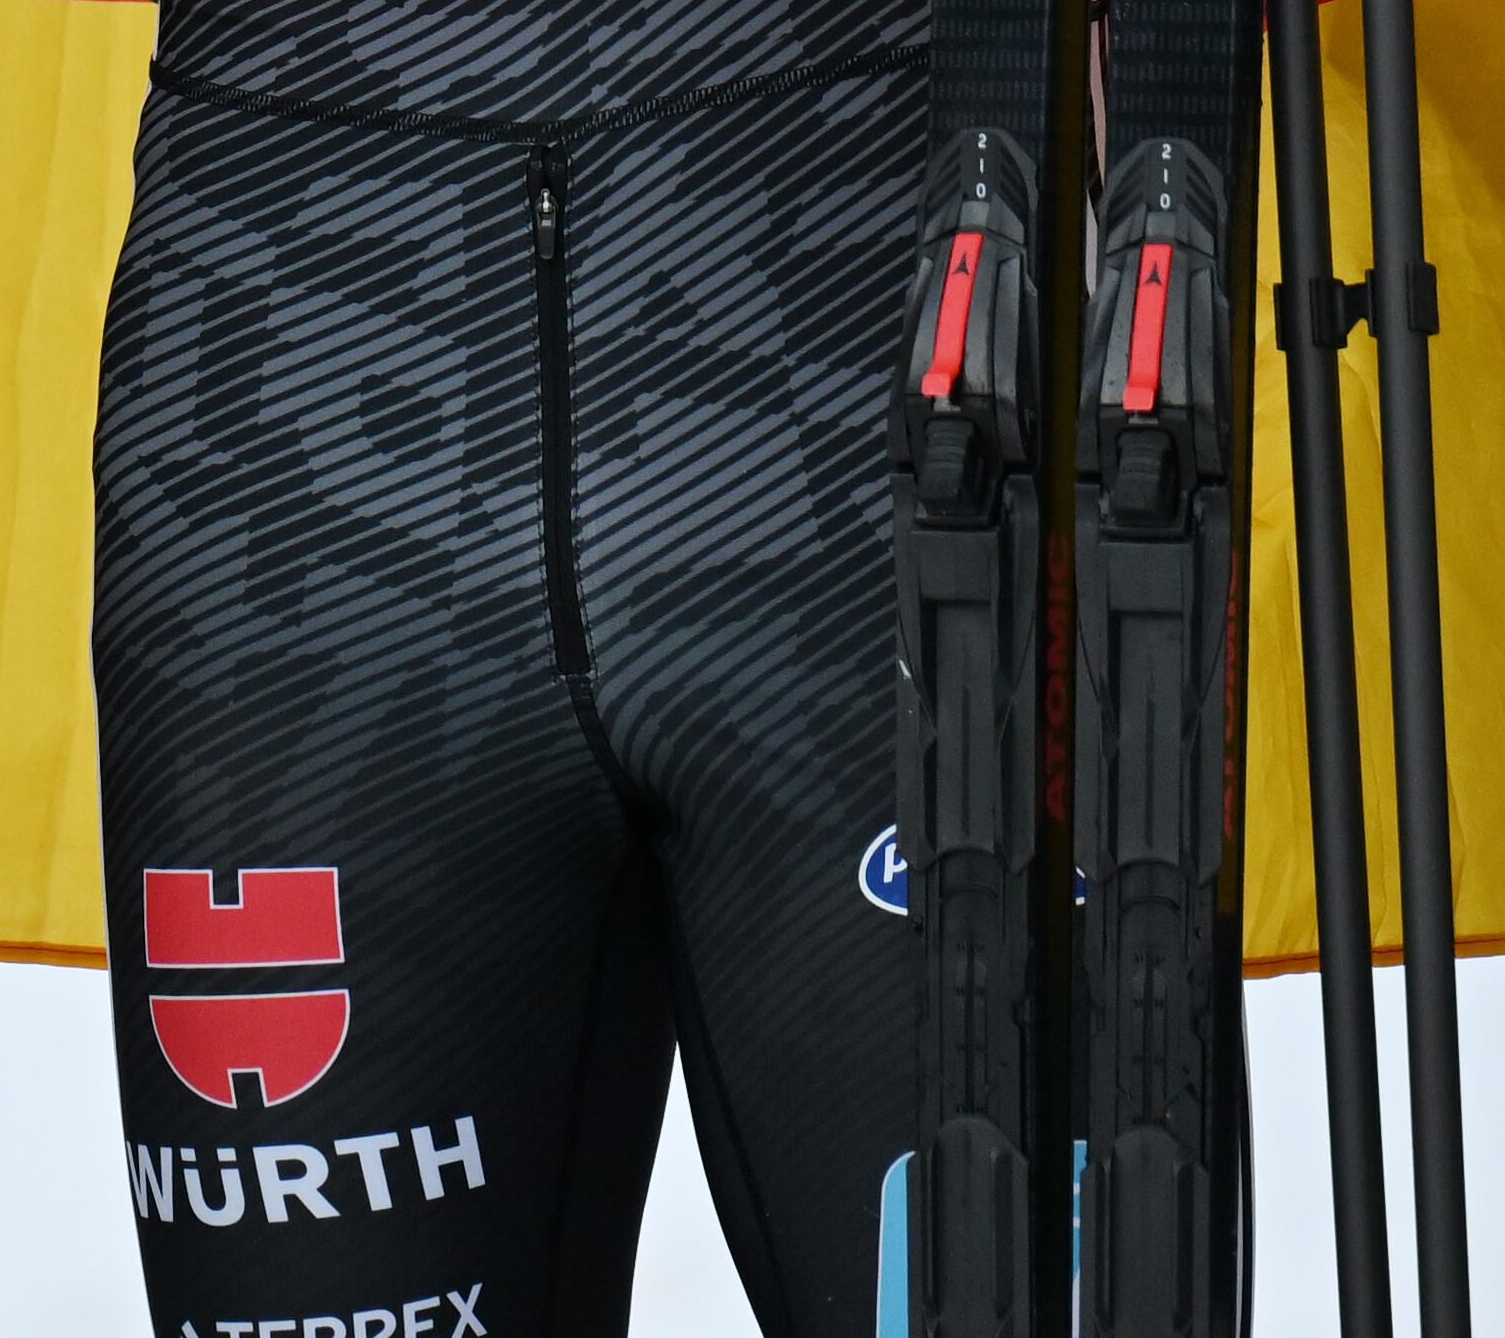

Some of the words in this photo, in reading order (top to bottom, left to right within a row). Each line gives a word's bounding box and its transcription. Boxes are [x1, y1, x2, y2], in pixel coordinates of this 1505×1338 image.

[977, 132, 988, 150] 2
[1161, 143, 1172, 160] 2
[125, 1115, 486, 1227] WÜRTH
